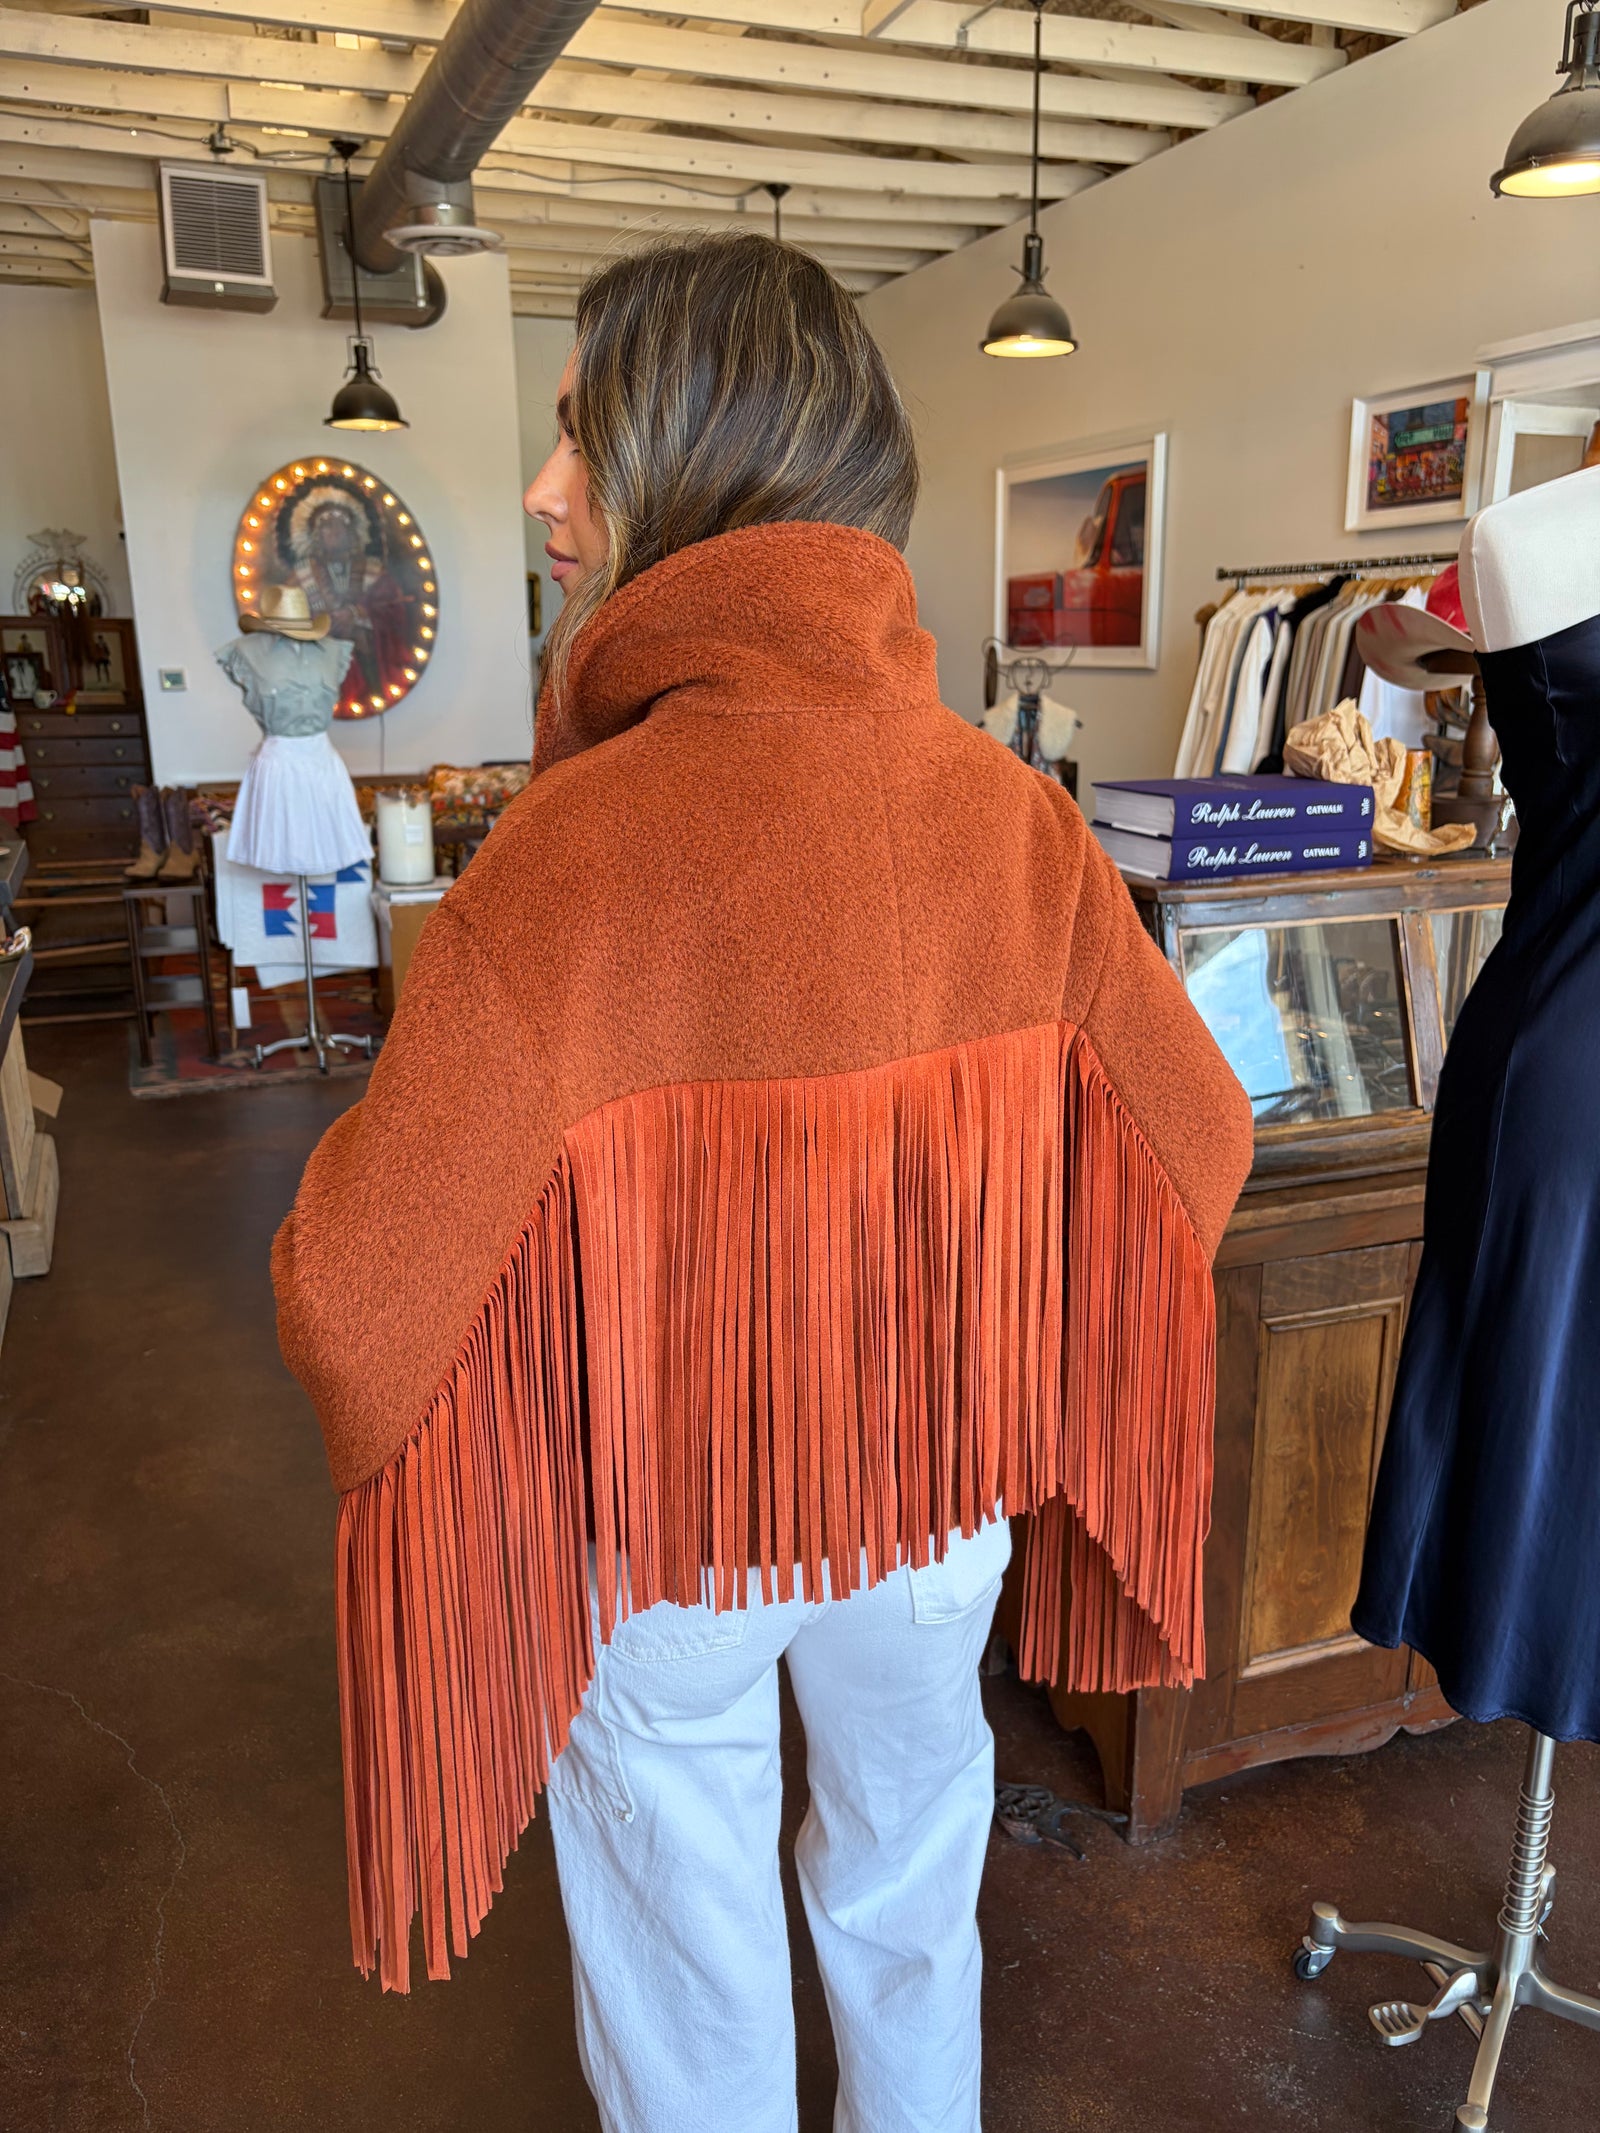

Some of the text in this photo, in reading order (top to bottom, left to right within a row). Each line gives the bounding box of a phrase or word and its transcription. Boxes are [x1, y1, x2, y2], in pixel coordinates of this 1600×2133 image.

[1190, 799, 1344, 829] Ralph Lauren CATWALK
[1187, 842, 1340, 872] Ralph Lauren CATWALK
